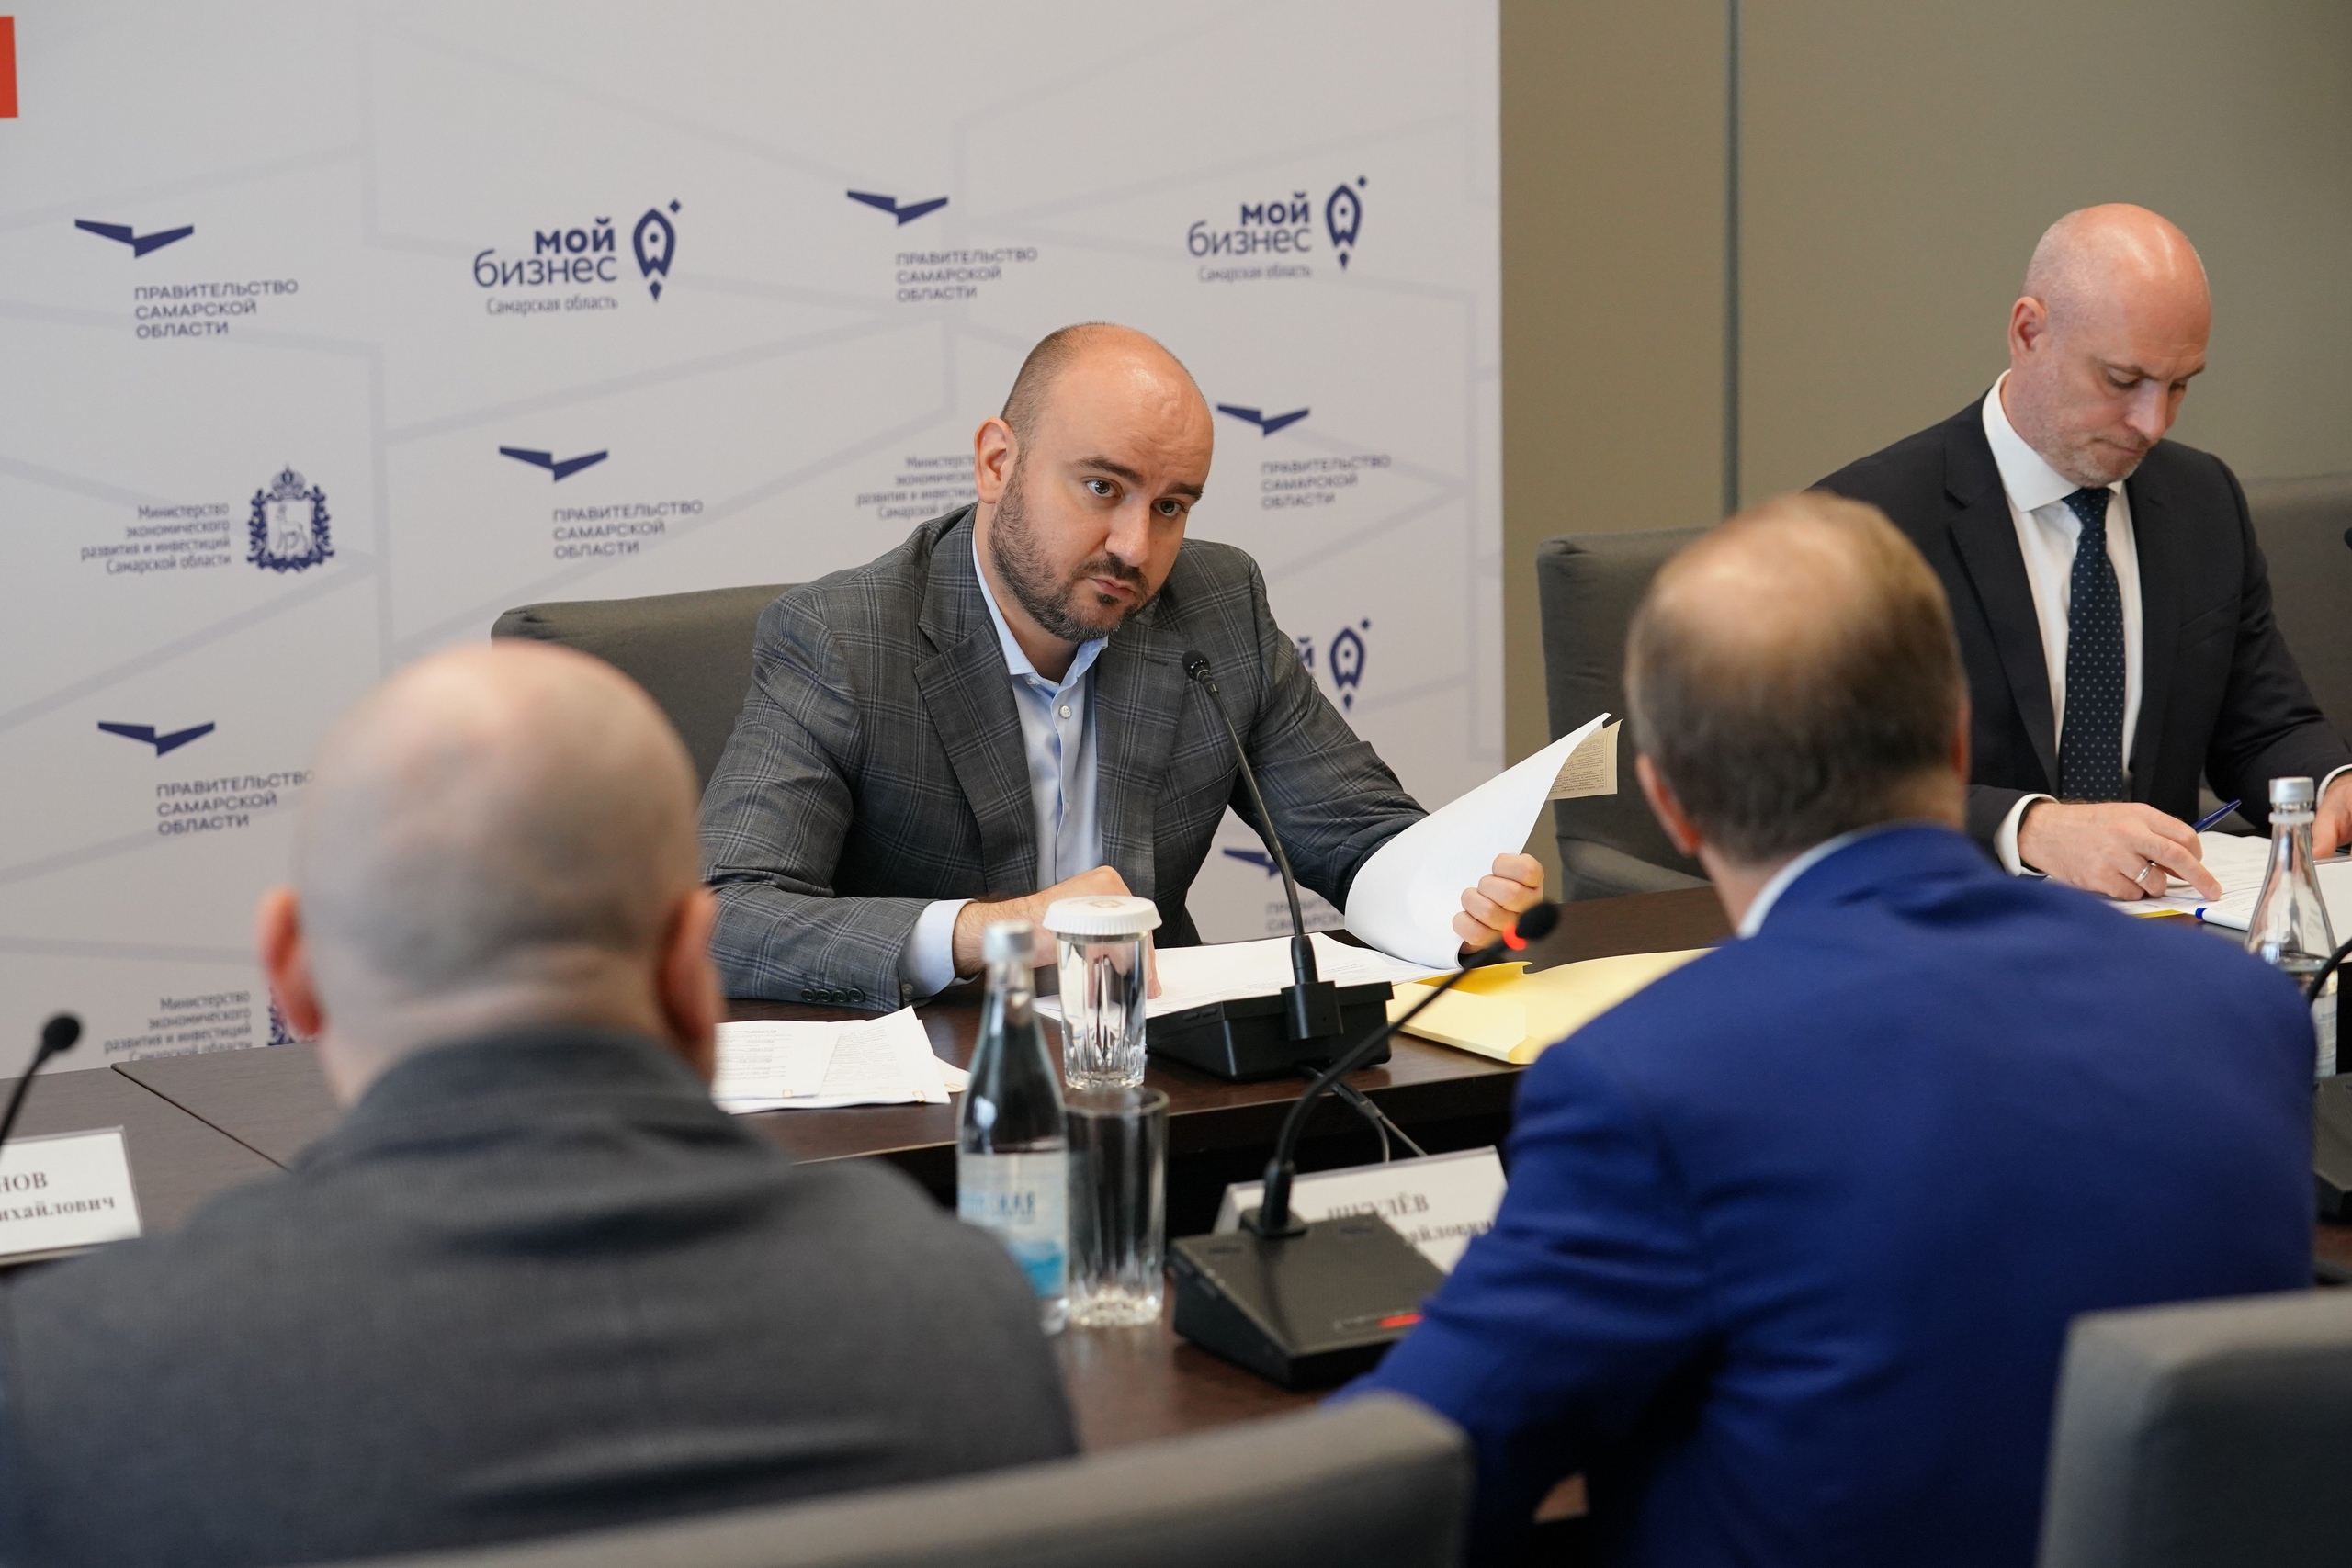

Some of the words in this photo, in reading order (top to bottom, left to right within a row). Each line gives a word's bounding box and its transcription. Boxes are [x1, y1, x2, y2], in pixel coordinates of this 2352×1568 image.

[1240, 191, 1310, 226] мой
[534, 217, 616, 255] мой
[1187, 220, 1313, 257] бизнес
[896, 247, 1038, 266] ПРАВИТЕЛЬСТВО
[473, 248, 618, 288] бизнес
[896, 266, 1002, 285] САМАРСКОЙ
[1198, 265, 1262, 284] Самарская
[1266, 264, 1312, 279] область
[134, 278, 299, 301] ПРАВИТЕЛЬСТВО
[896, 286, 978, 303] ОБЛАСТИ
[135, 299, 258, 321] САМАРСКОЙ
[486, 296, 561, 316] Самарская
[564, 292, 618, 312] область
[136, 321, 230, 341] ОБЛАСТИ
[1261, 454, 1392, 474] ПРАВИТЕЛЬСТВО
[1261, 473, 1359, 493] САМАРСКОЙ
[138, 502, 230, 518] Министерство
[552, 499, 704, 522] ПРАВИТЕЛЬСТВО
[1261, 492, 1336, 510] ОБЛАСТИ
[125, 520, 230, 538] экономического
[553, 519, 665, 541] САМАРСКОЙ
[81, 544, 141, 561] развития
[142, 543, 152, 553] и
[155, 536, 231, 552] инвестиций
[553, 540, 639, 560] ОБЛАСТИ
[106, 555, 176, 576] Самарской
[180, 554, 231, 569] области
[156, 769, 315, 797] ПРАВИТЕЛЬСТВО
[156, 790, 277, 818] САМАРСКОЙ
[157, 814, 249, 837] ОБЛАСТИ
[160, 991, 251, 1010] Министерство
[148, 1008, 251, 1031] экономического
[104, 1034, 163, 1055] развития
[177, 1021, 252, 1043] инвестиций
